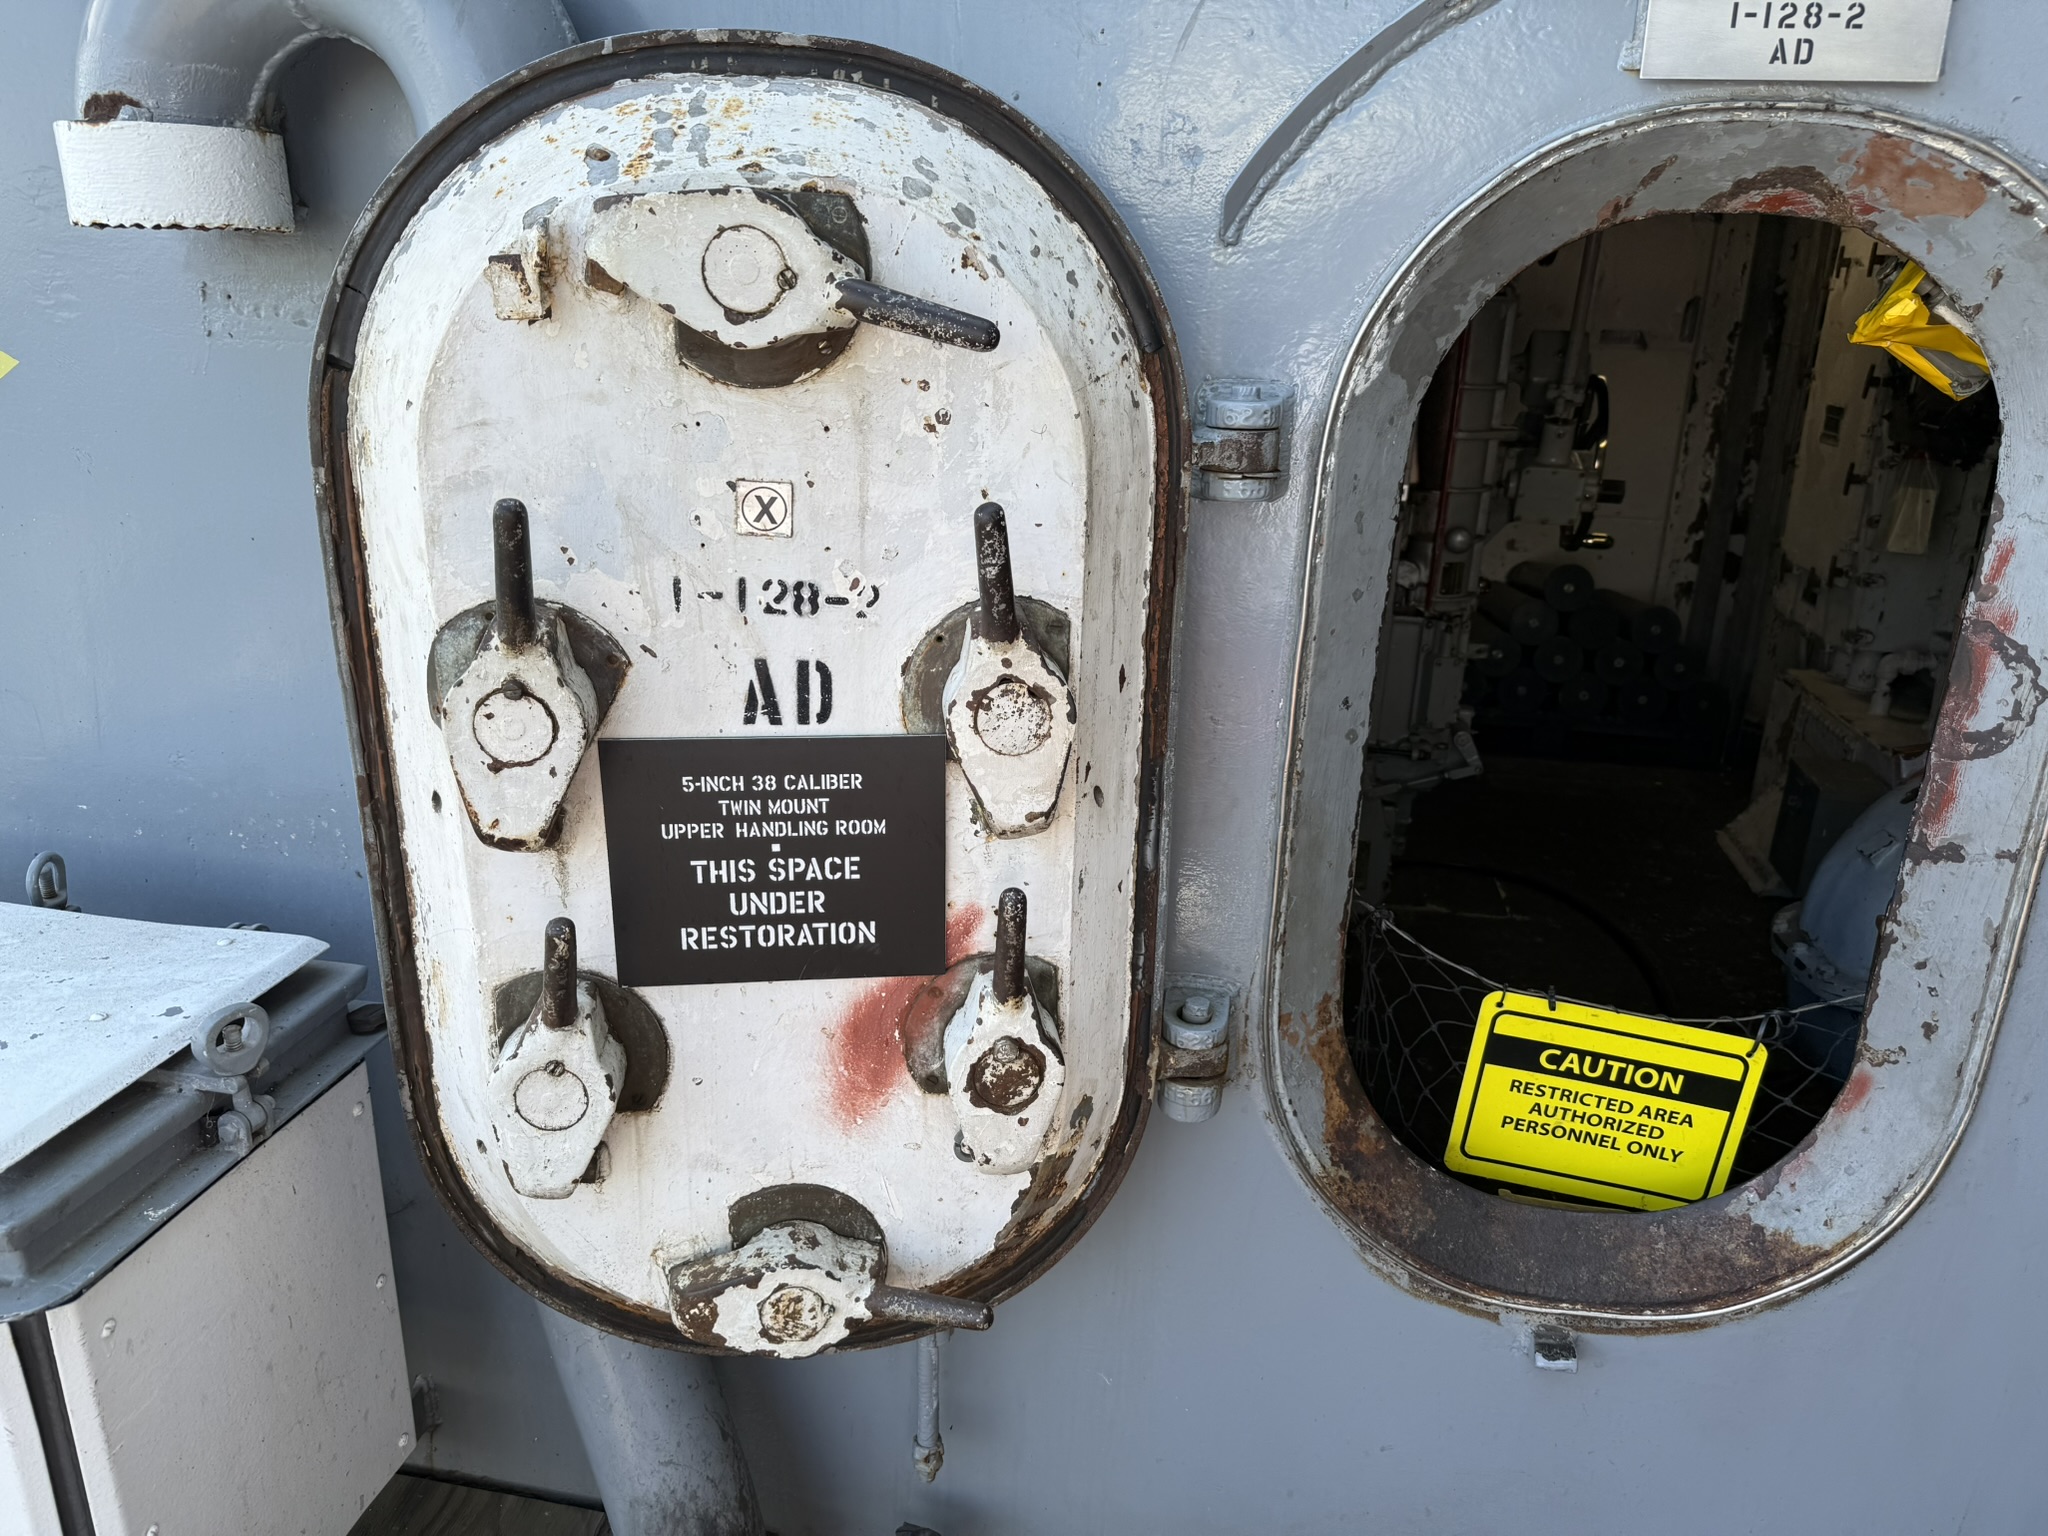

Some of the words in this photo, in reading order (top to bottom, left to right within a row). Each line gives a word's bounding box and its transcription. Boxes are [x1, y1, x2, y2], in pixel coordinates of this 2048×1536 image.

[1730, 1, 1866, 29] 1-128-2
[1769, 37, 1814, 65] AD
[752, 494, 779, 525] X
[743, 658, 833, 726] AD
[681, 775, 745, 793] 5-INCH
[751, 774, 777, 792] 38
[783, 773, 863, 791] CALIBER
[717, 799, 762, 816] TWIN
[767, 797, 830, 815] MOUNT
[661, 822, 725, 840] UPPER
[735, 820, 829, 838] HANDLING
[835, 818, 886, 836] ROOM
[689, 859, 756, 884] THIS
[768, 856, 861, 882] SPACE
[729, 890, 826, 916] UNDER
[680, 920, 876, 951] RESTORATION
[1539, 1048, 1685, 1095] CAUTION
[1508, 1079, 1635, 1115] RESTRICTED
[1636, 1104, 1694, 1129] AREA
[1527, 1102, 1665, 1140] AUTHORIZED
[1500, 1115, 1622, 1151] PERSONNEL
[1626, 1141, 1685, 1164] ONLY
